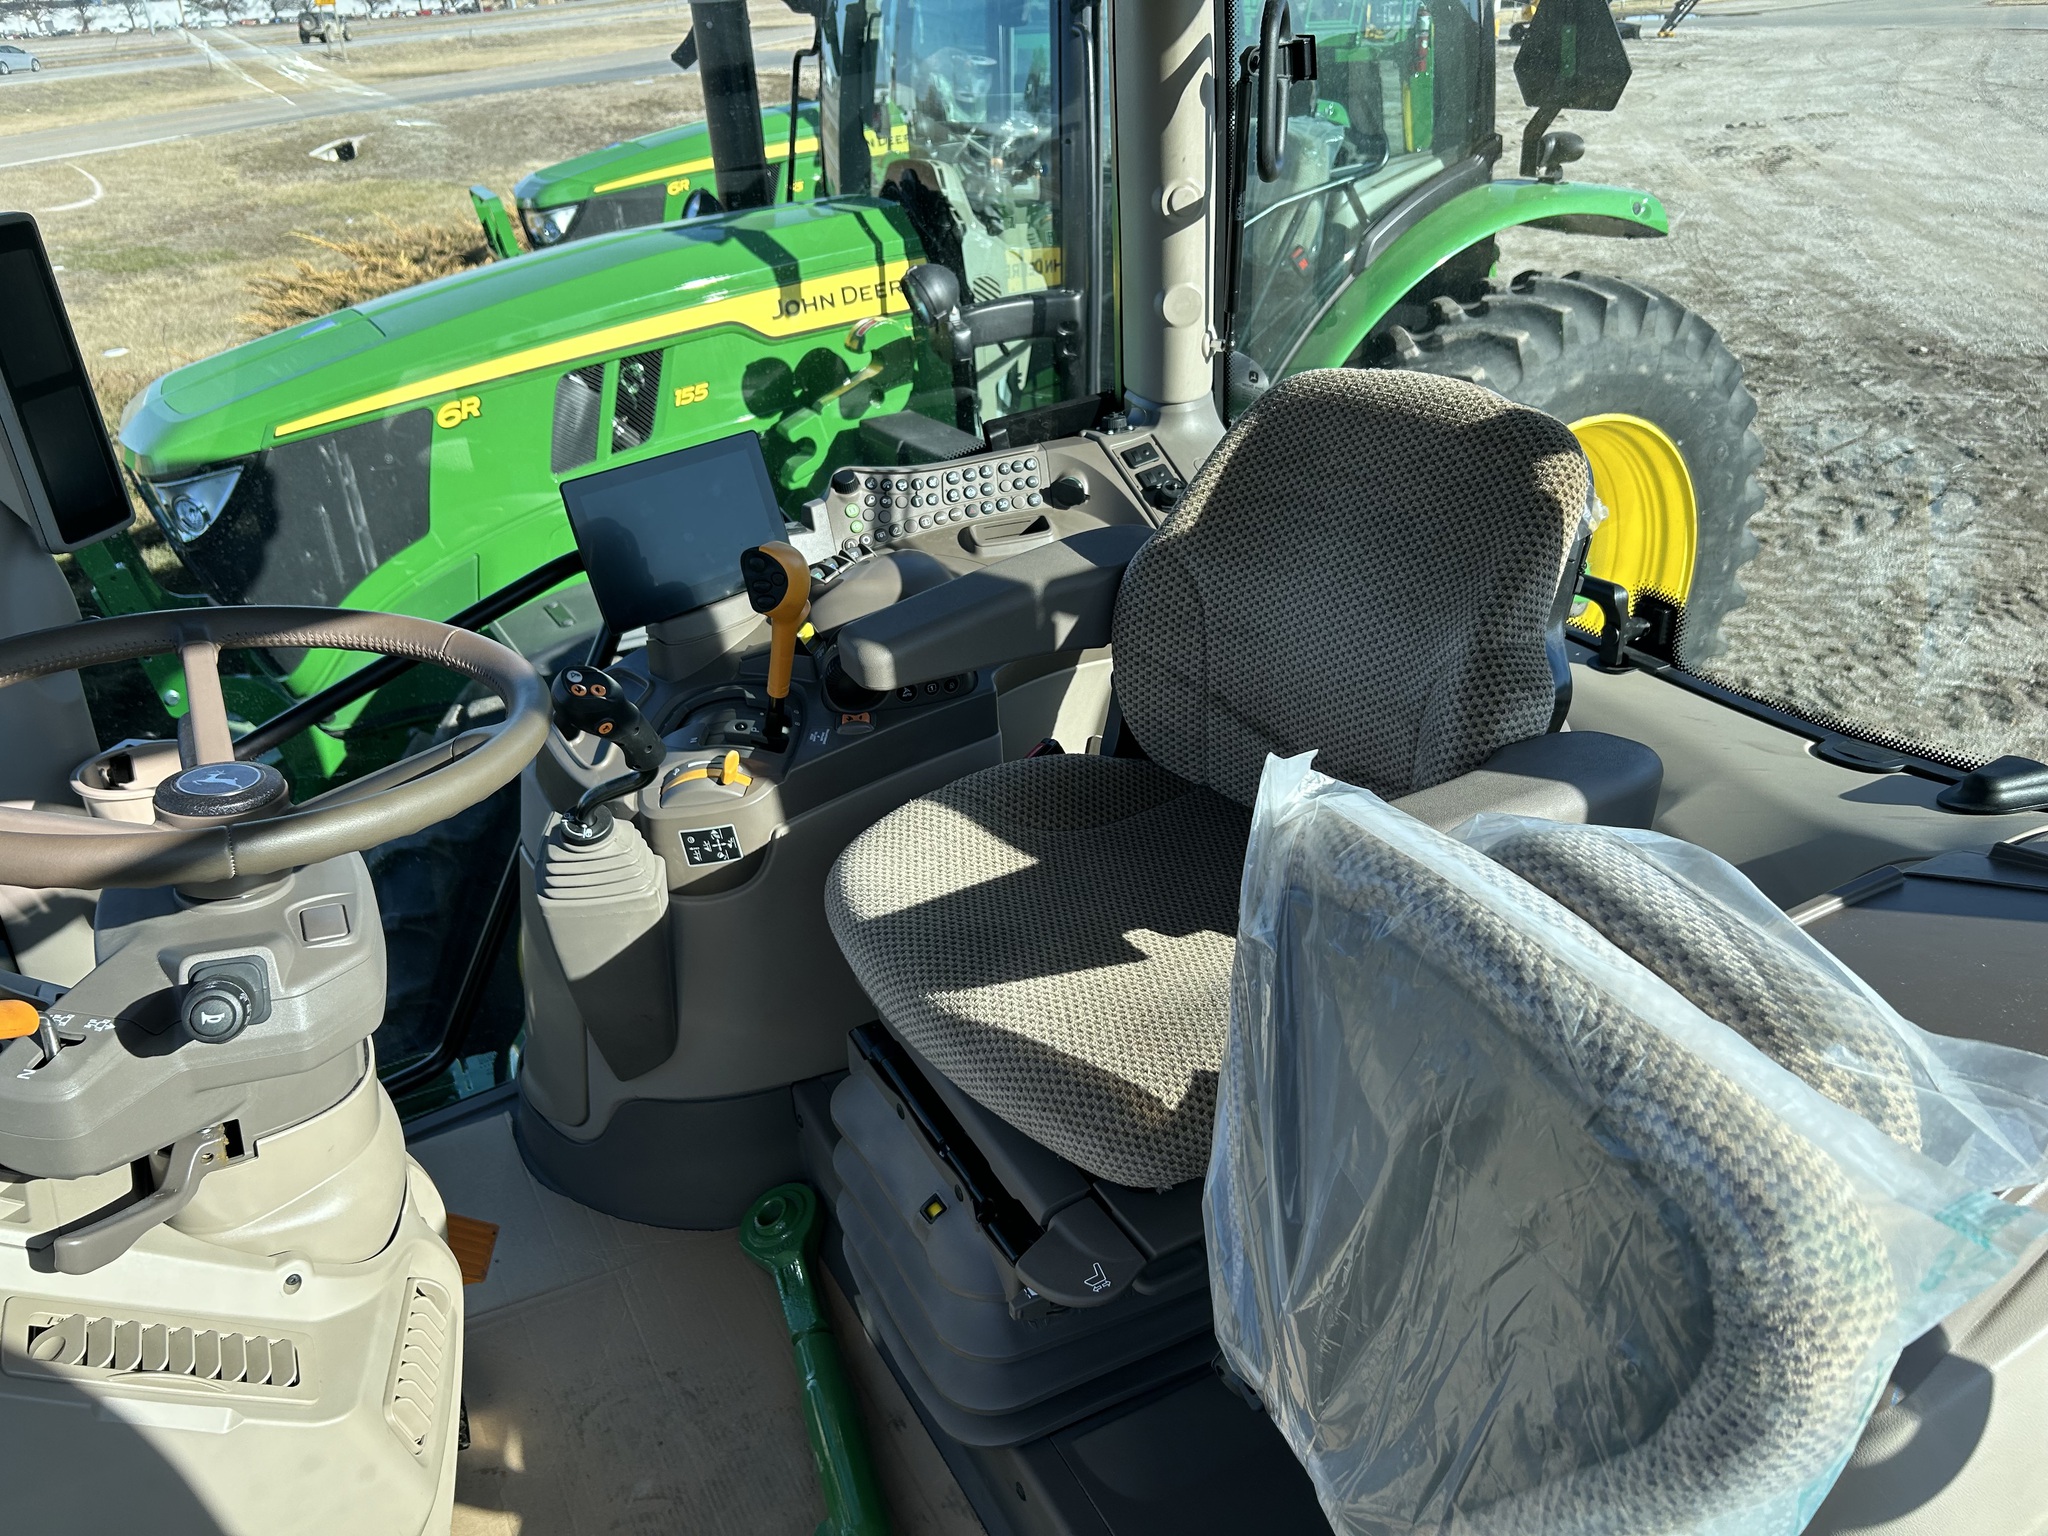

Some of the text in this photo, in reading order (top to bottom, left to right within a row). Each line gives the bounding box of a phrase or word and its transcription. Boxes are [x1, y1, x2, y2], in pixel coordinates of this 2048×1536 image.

[667, 178, 690, 195] 6R
[772, 279, 904, 320] JOHN DEER
[674, 382, 710, 407] 155
[437, 395, 482, 429] 6R
